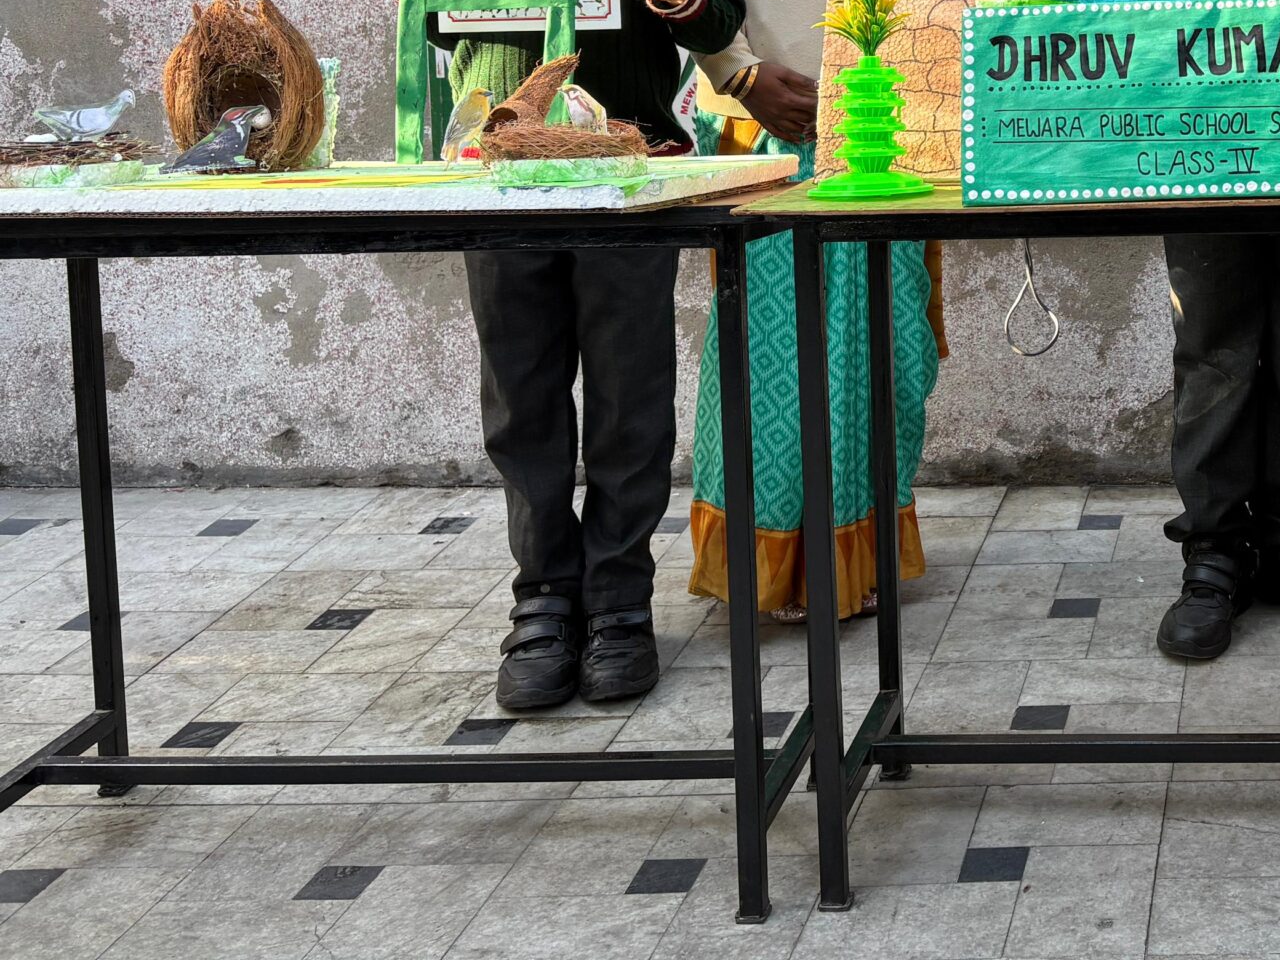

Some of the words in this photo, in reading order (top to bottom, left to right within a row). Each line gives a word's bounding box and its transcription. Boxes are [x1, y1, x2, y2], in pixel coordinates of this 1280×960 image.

[986, 33, 1135, 82] DHRUV
[998, 115, 1085, 138] MEWARA
[1099, 113, 1165, 137] PUBLIC
[1179, 111, 1256, 136] SCHOOL
